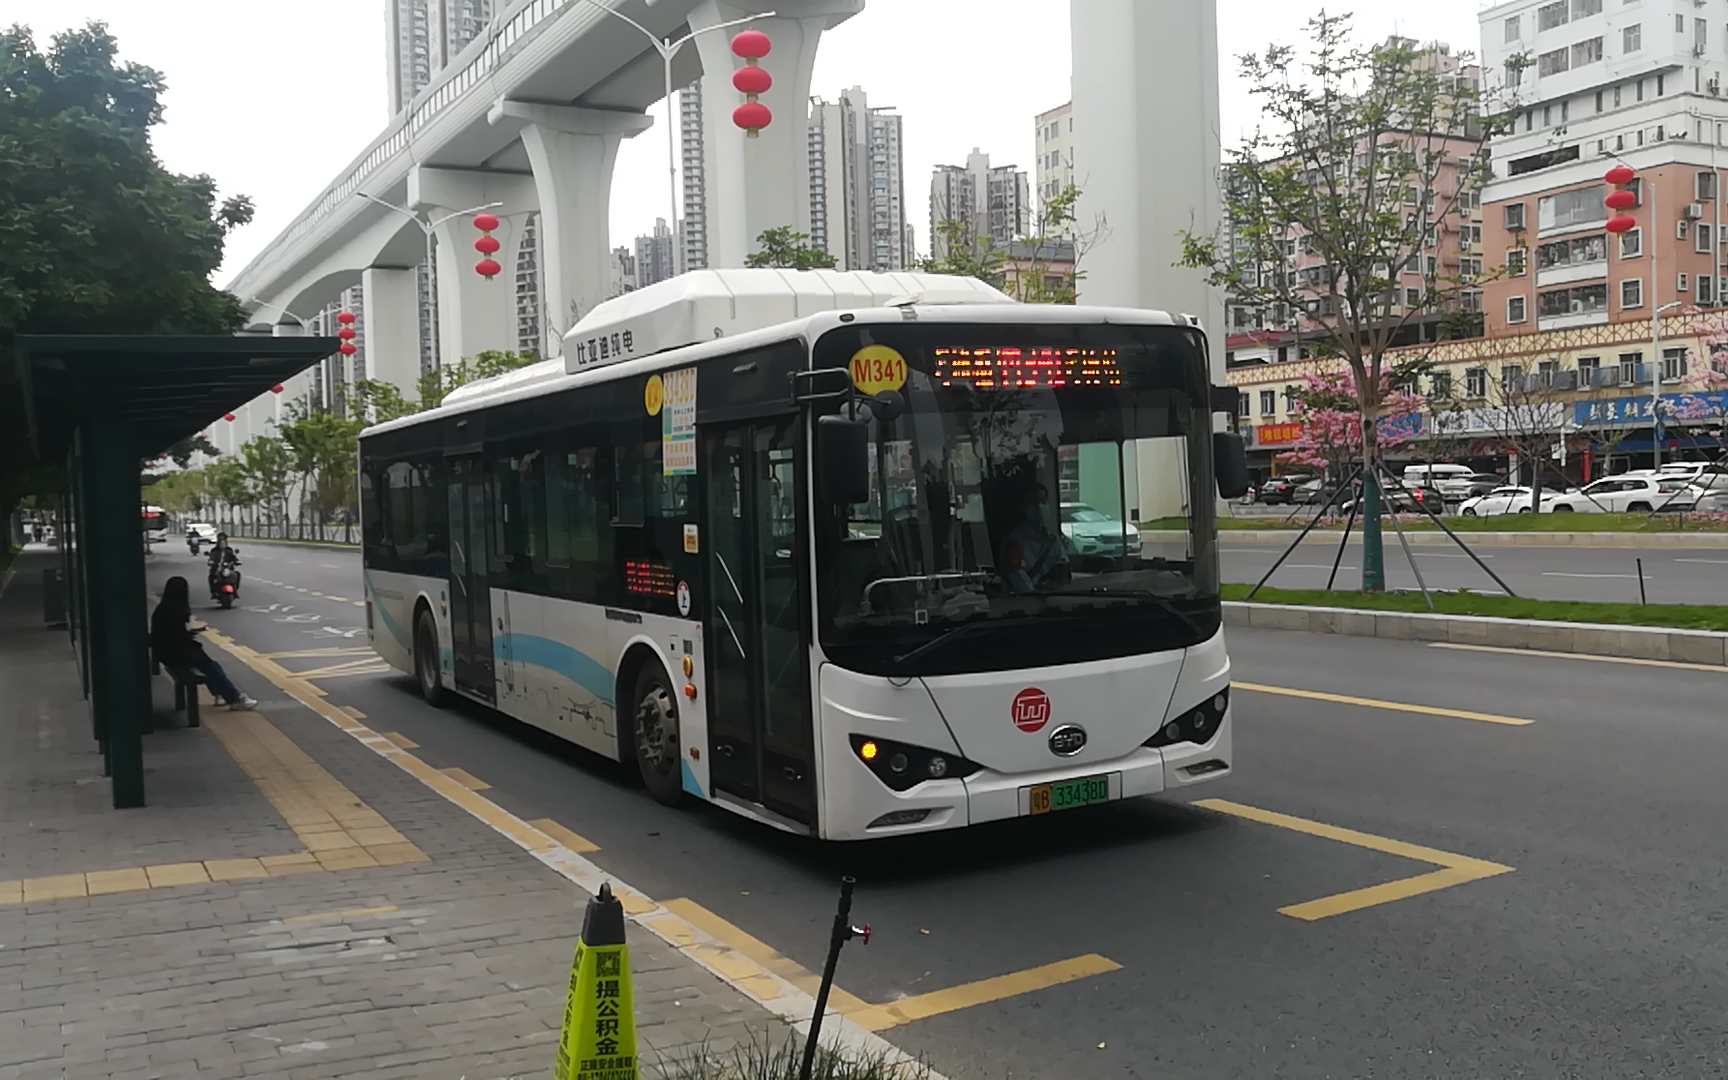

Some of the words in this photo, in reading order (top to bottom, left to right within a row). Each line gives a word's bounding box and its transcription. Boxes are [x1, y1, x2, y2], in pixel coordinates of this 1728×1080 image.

[577, 329, 634, 365] 比亚迪纯电
[854, 359, 904, 384] M341
[595, 980, 620, 1056] 提公积金
